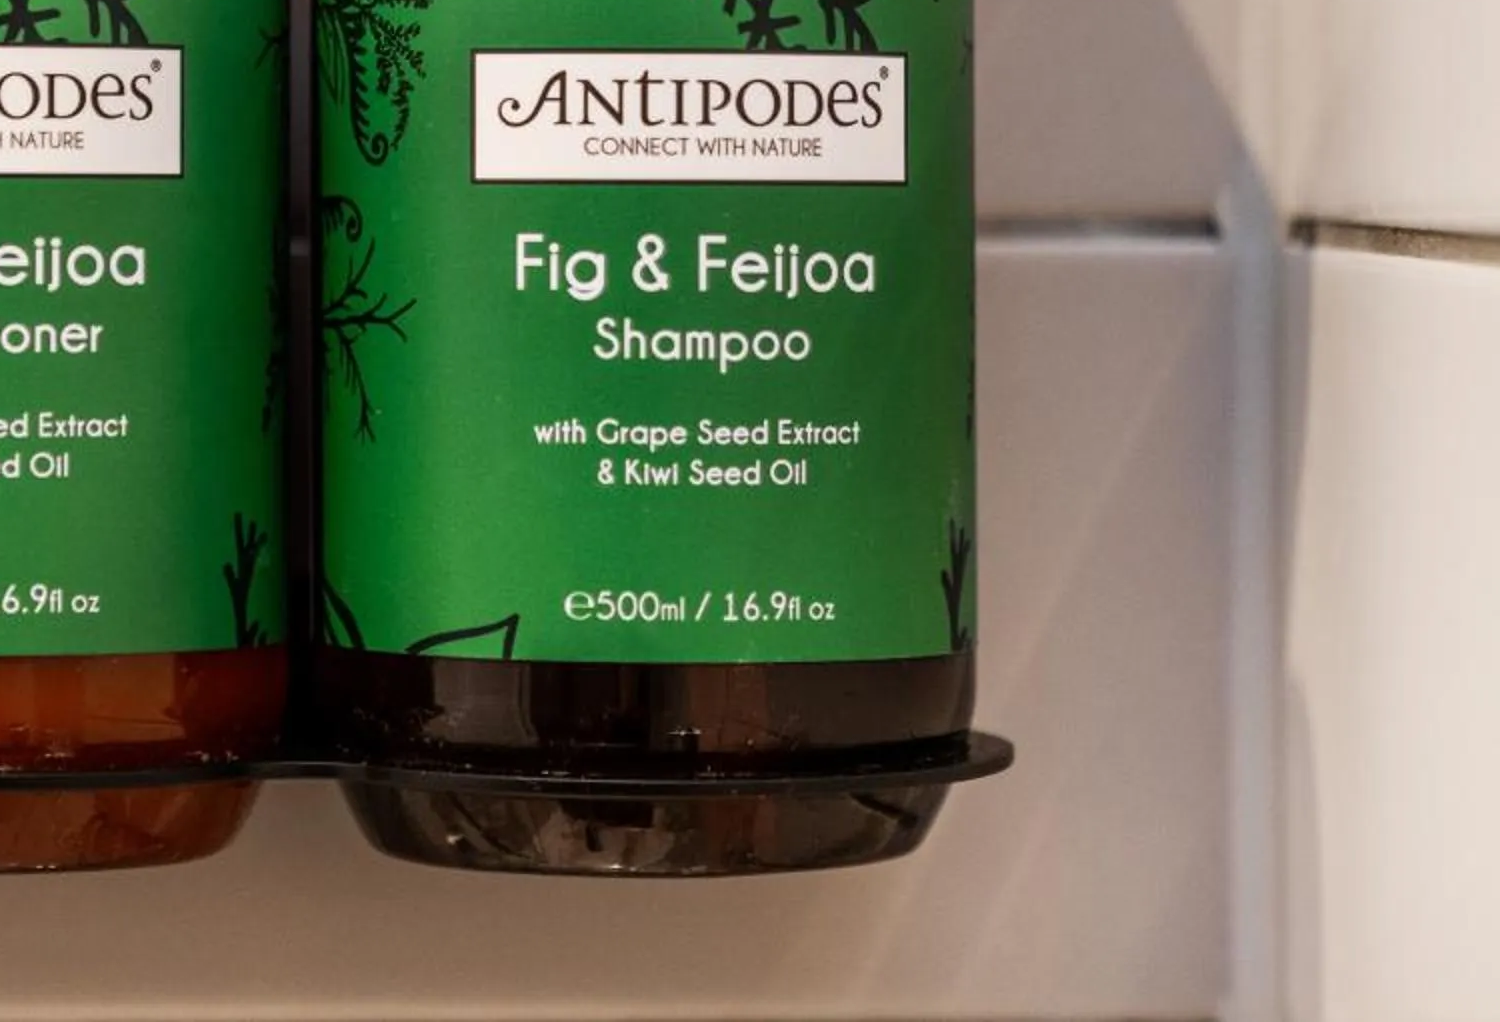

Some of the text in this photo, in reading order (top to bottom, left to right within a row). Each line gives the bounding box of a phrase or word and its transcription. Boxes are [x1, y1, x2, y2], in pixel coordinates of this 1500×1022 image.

[9, 130, 85, 150] NATURE
[583, 136, 823, 158] CONNECT WITH NATURE
[515, 232, 875, 302] Fig & Feijoa
[593, 316, 811, 374] Shampoo
[38, 411, 129, 438] Extract
[533, 417, 861, 453] with Grape Seed Extract
[29, 451, 70, 479] Oil
[597, 458, 807, 486] & Kiwi Seed Oil
[70, 594, 101, 614] oz
[694, 591, 712, 622] /
[723, 590, 801, 622] 16.9fl
[807, 601, 836, 621] oz
